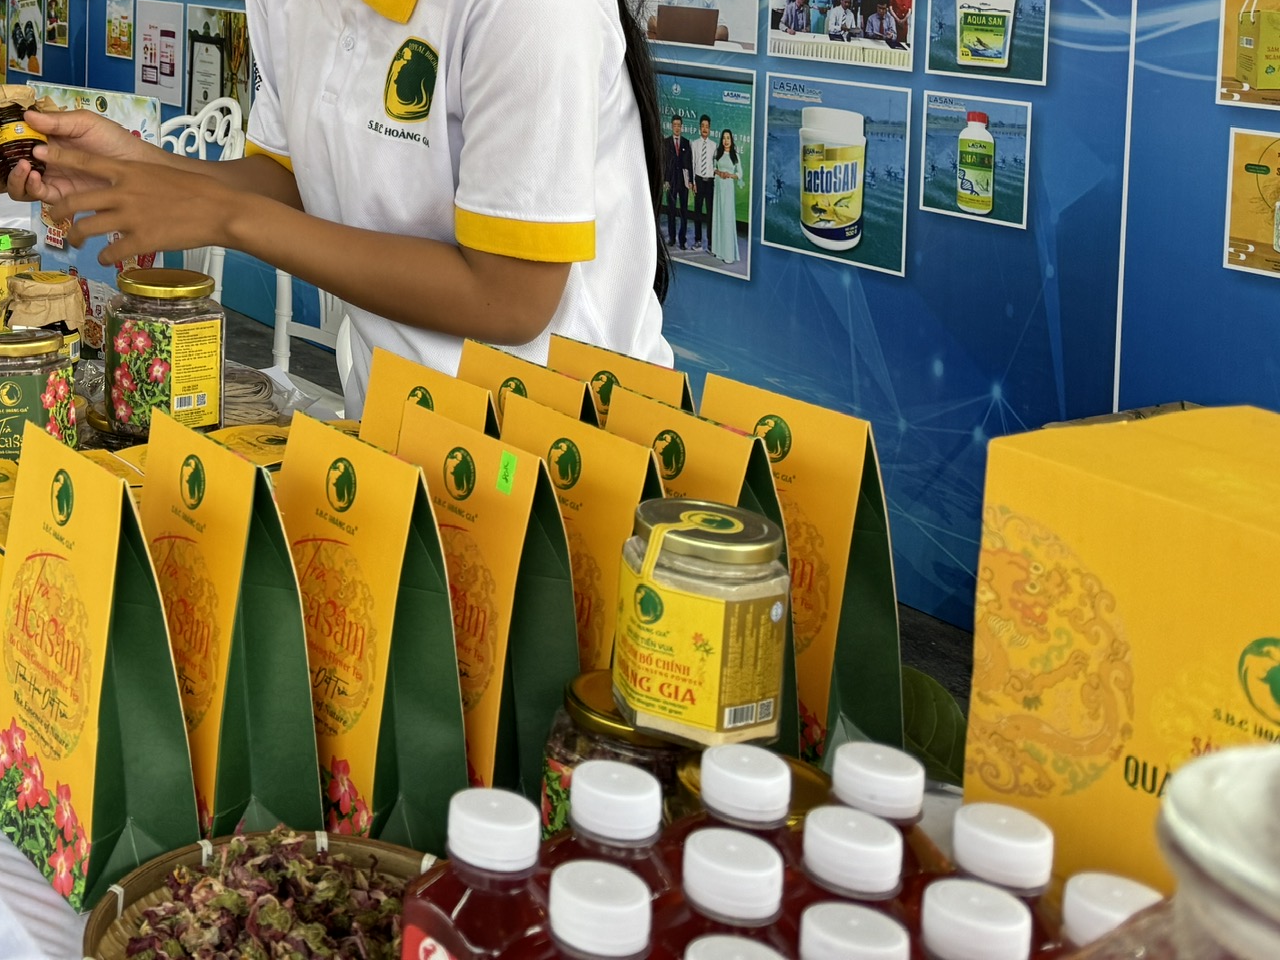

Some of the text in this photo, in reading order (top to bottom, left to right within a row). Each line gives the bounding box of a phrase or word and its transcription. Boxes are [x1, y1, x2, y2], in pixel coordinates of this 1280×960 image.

[967, 14, 1003, 26] AQUA SAN
[773, 80, 805, 93] LASAN
[929, 96, 954, 105] LASAN
[384, 127, 420, 142] HOÀNG
[655, 658, 691, 676] CHÍNH
[658, 682, 697, 706] GIA
